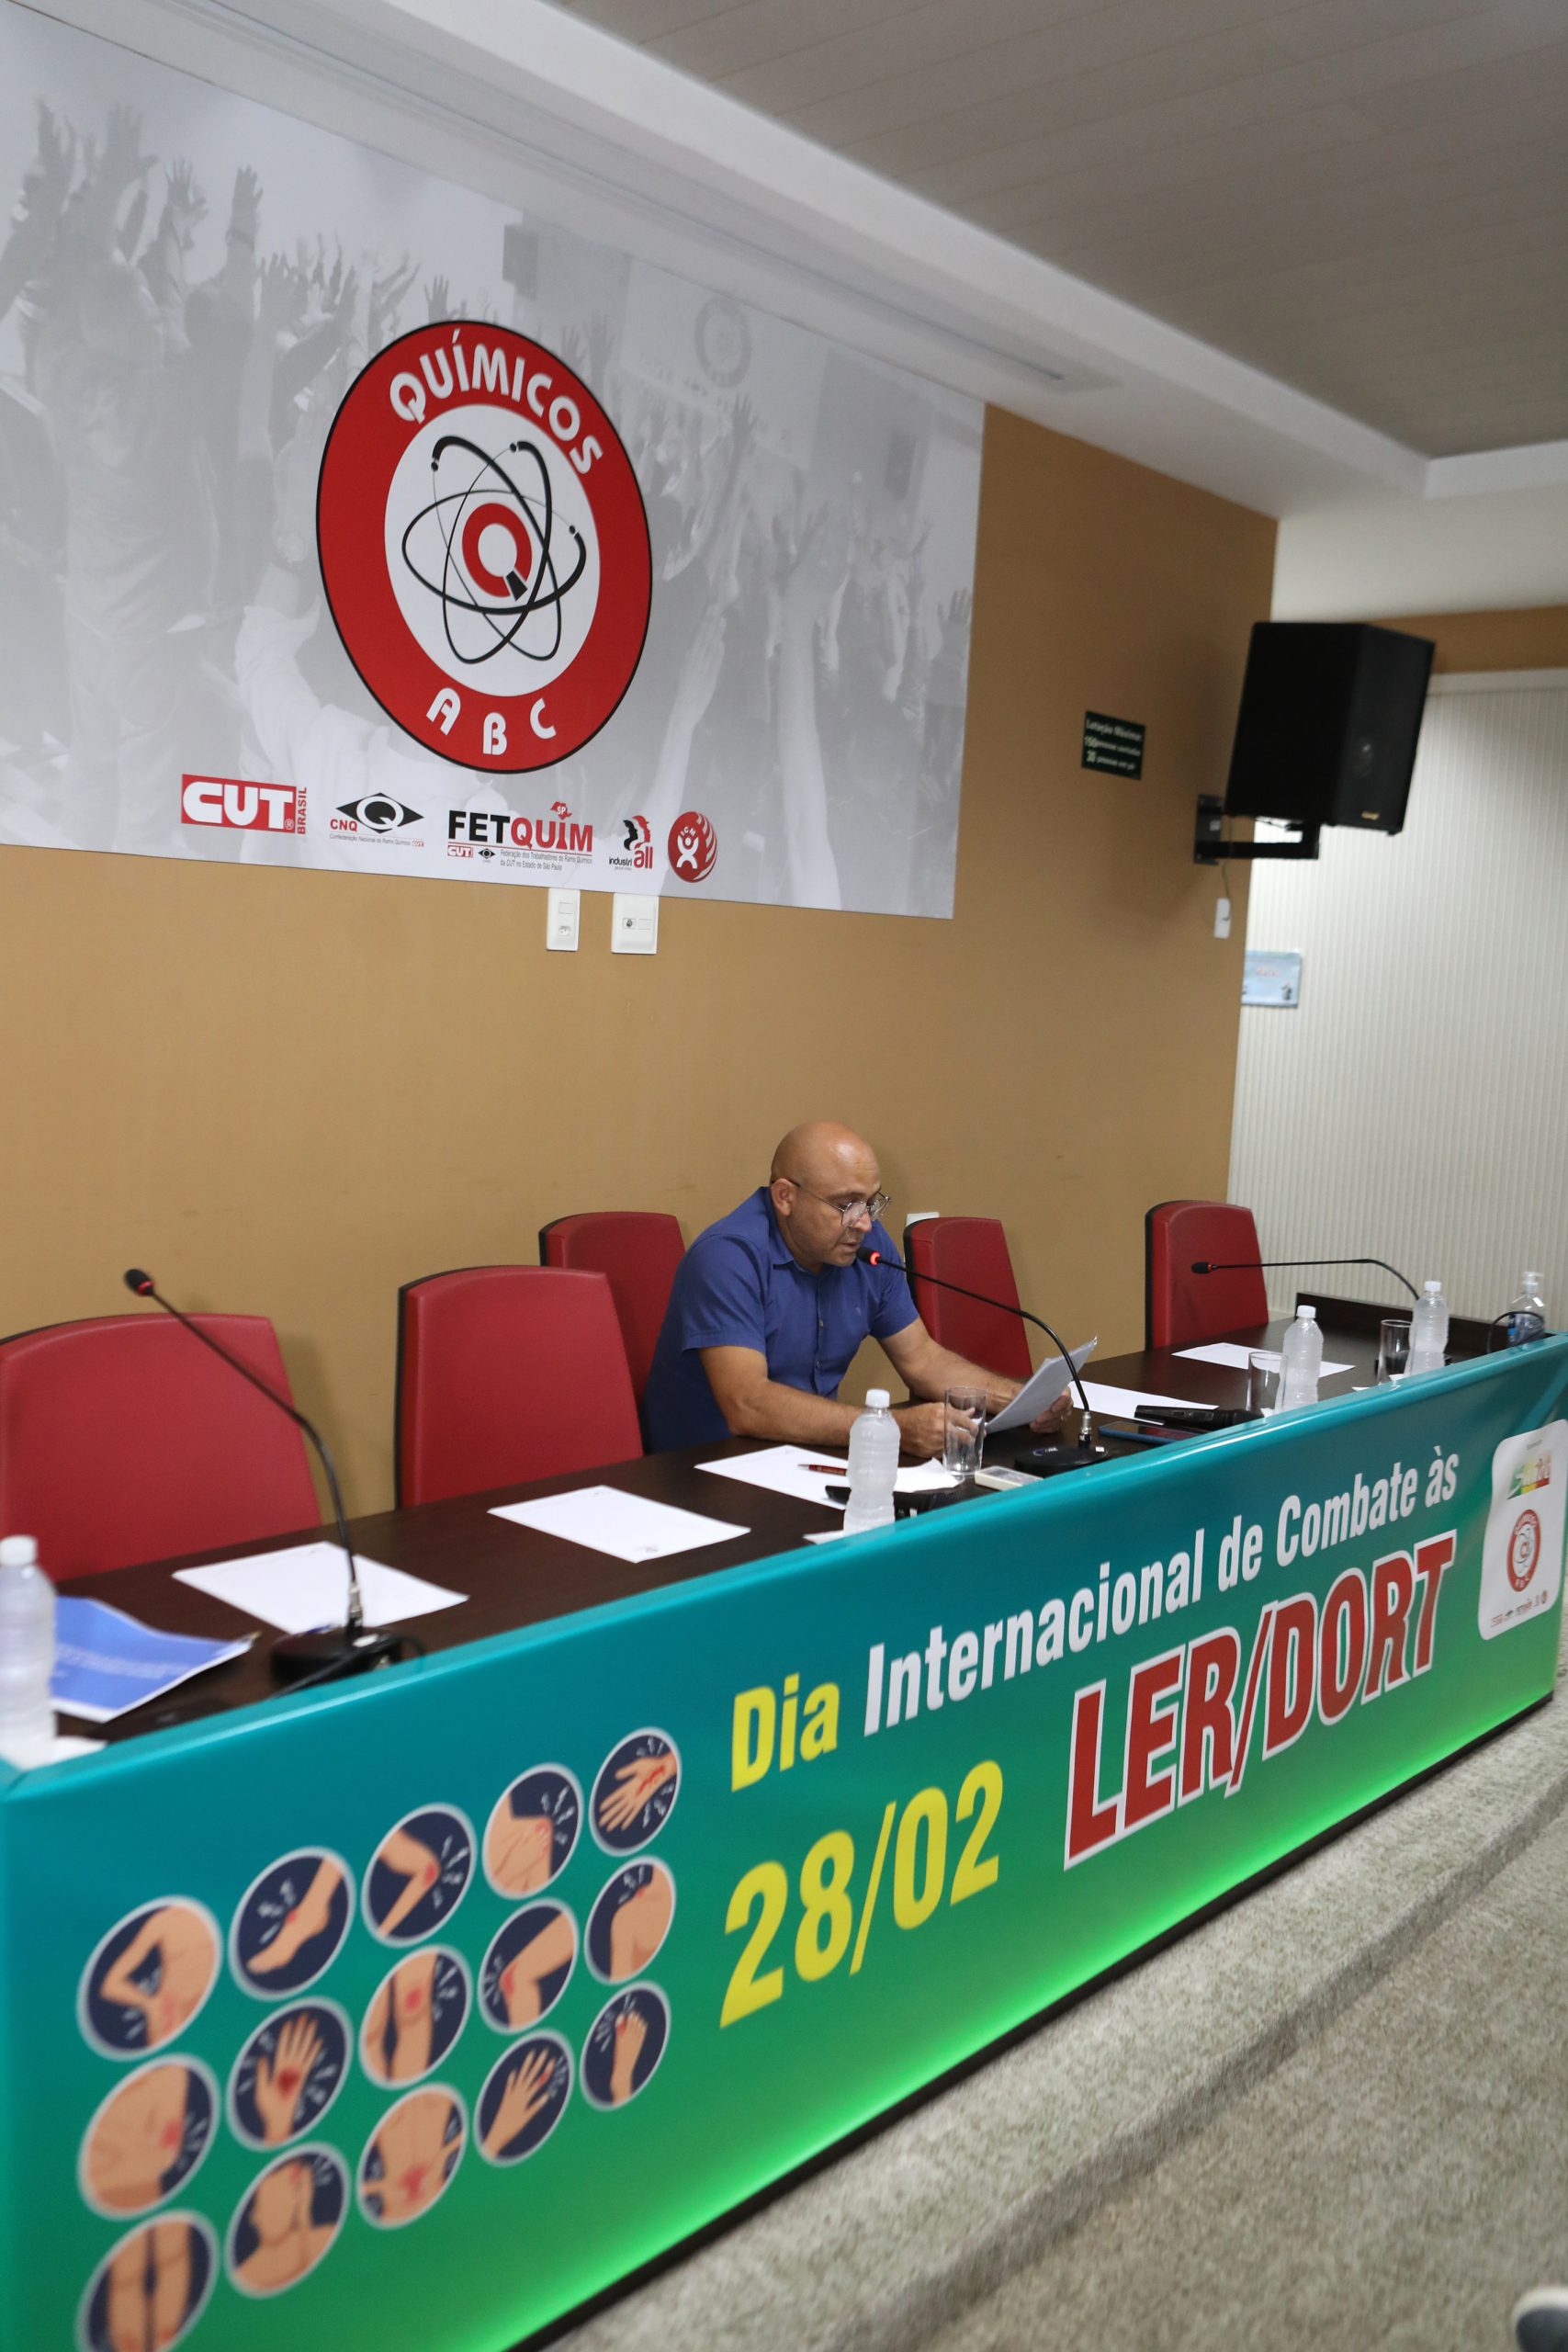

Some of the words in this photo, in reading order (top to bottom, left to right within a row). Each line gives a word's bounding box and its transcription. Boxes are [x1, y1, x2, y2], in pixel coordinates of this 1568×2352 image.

[389, 328, 604, 475] QUÍMICOS
[183, 781, 293, 830] CUT
[297, 786, 307, 834] BRASIL
[330, 819, 357, 831] CNQ
[556, 806, 567, 816] SP
[447, 846, 471, 857] CUT
[732, 1672, 839, 1792] Dia
[864, 1528, 1206, 1736] Internacional
[1219, 1515, 1263, 1591] de
[1276, 1467, 1417, 1568] Combate
[1425, 1445, 1460, 1509] às
[1064, 1530, 1459, 1871] LER/DORT
[719, 1759, 1004, 2028] 28/02
